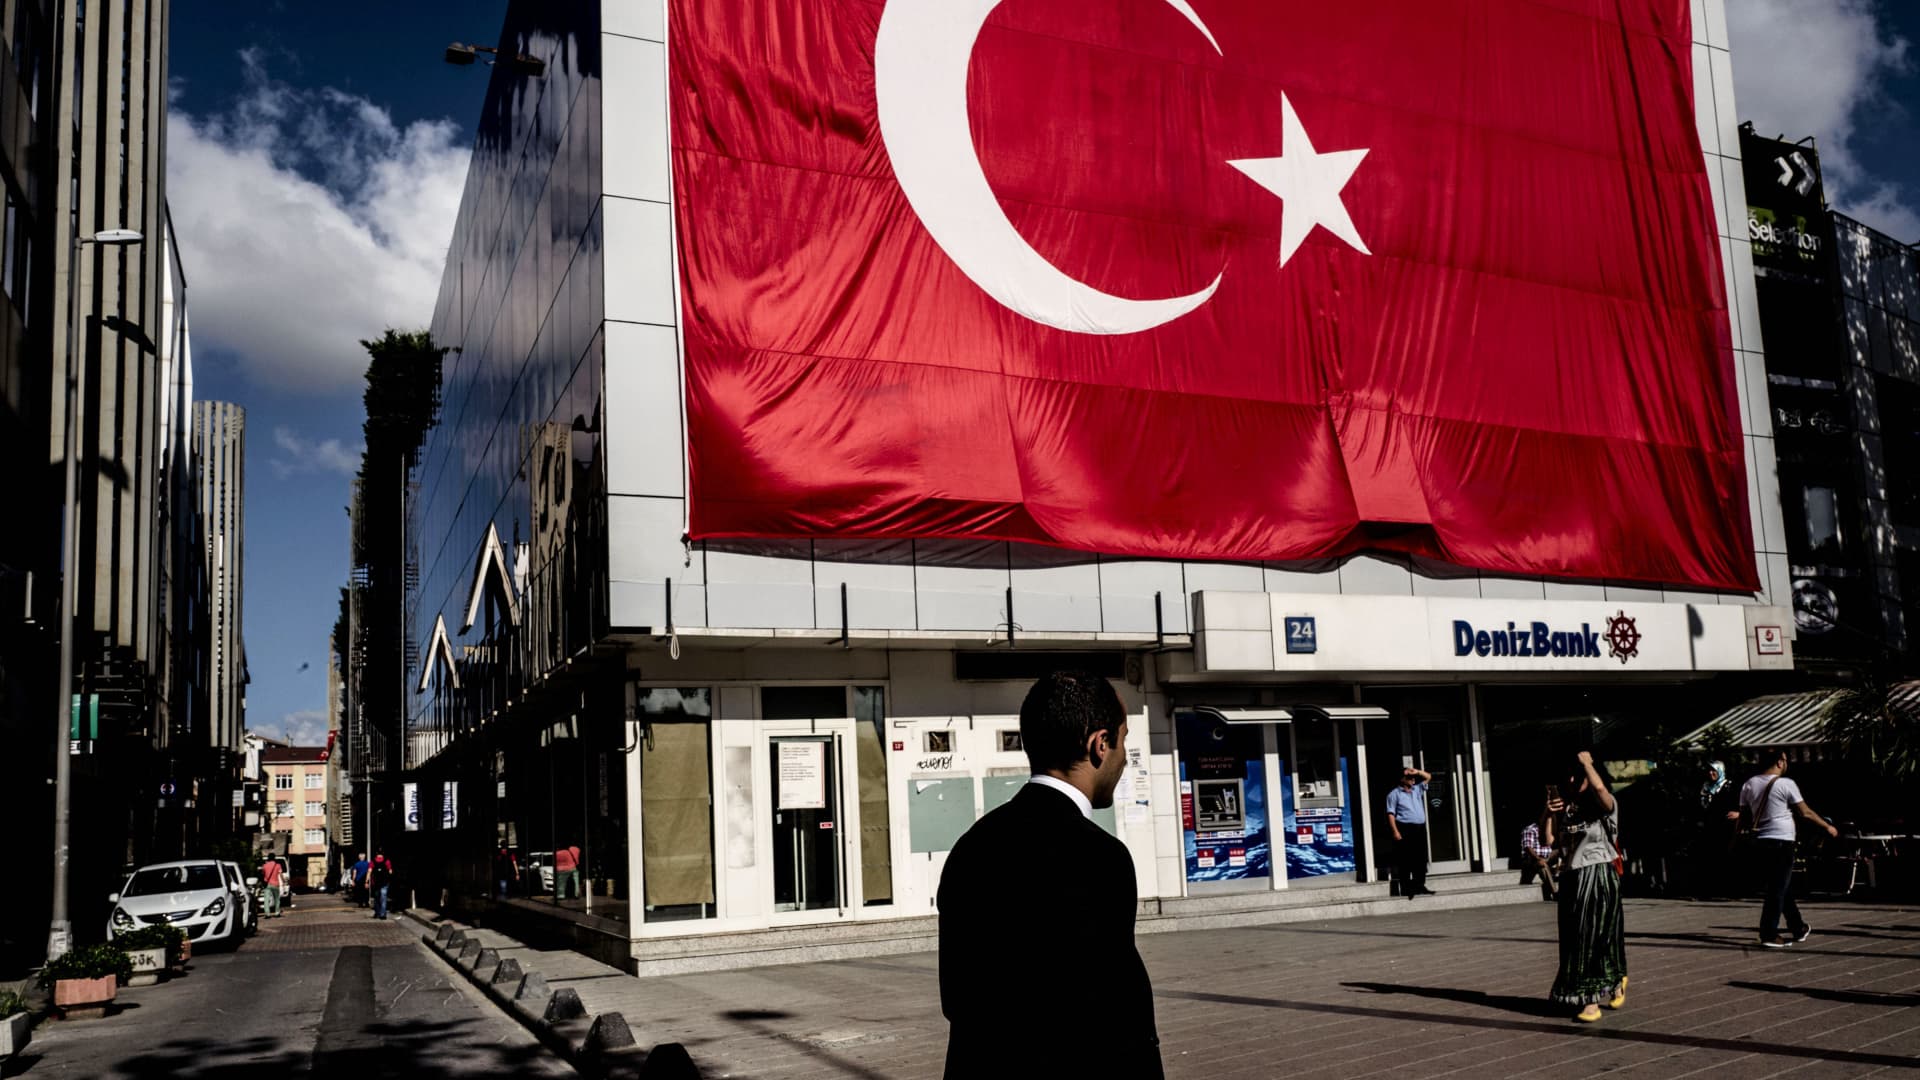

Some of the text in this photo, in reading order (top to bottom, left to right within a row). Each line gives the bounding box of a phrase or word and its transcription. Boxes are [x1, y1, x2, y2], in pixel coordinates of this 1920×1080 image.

[1748, 218, 1822, 252] Selection
[1290, 621, 1314, 639] 24
[1452, 619, 1602, 657] DenizBank
